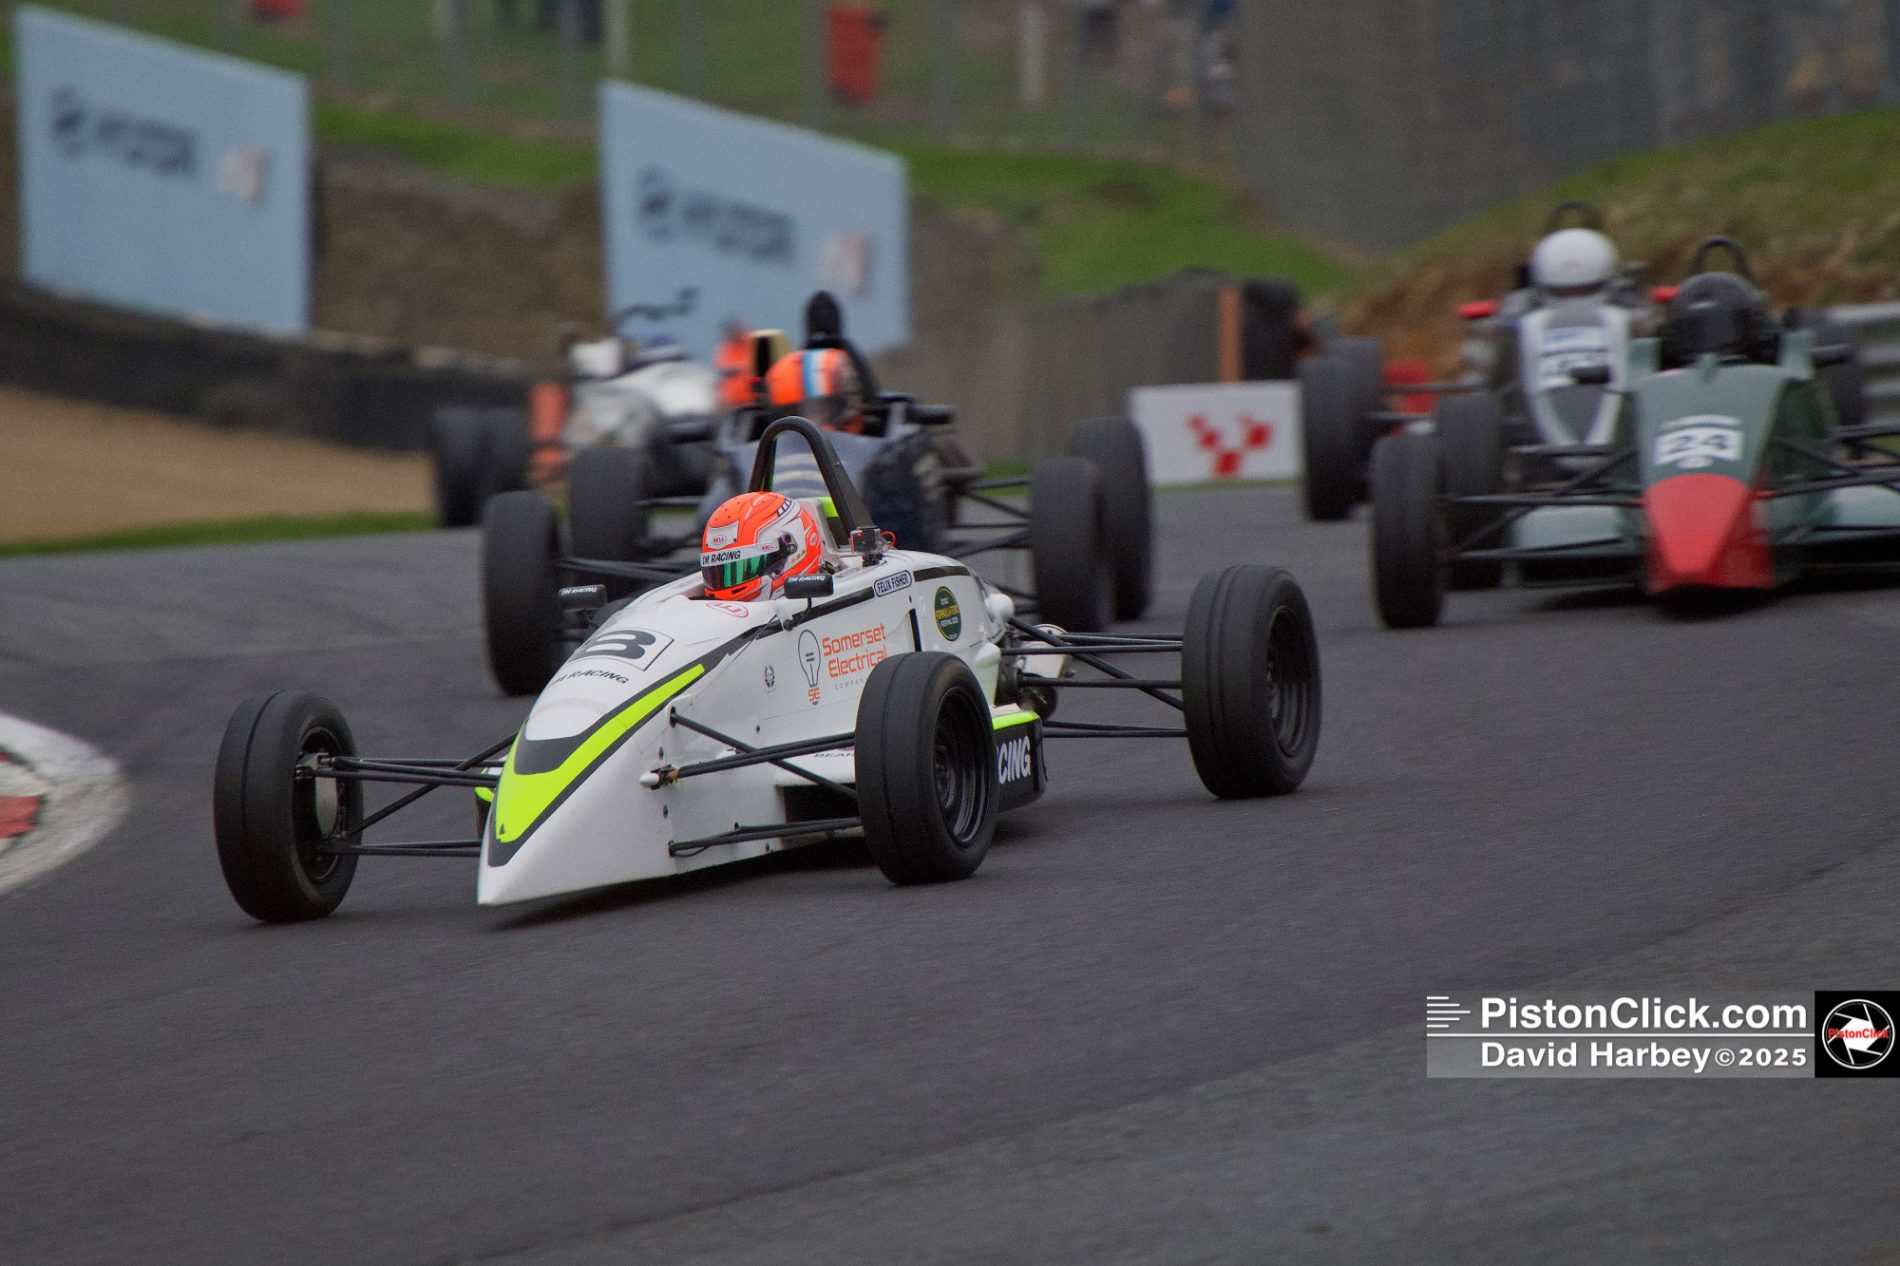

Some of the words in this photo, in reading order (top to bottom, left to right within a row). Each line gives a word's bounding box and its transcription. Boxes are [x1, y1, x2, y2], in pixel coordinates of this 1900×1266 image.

[711, 550, 741, 562] RACING
[877, 579, 892, 593] FELIX
[892, 573, 909, 589] FISHER
[821, 623, 886, 657] Somerset
[827, 643, 888, 678] Electrical
[568, 669, 630, 684] RACING
[834, 678, 865, 690] COMPAN
[808, 687, 820, 701] SE
[996, 735, 1031, 785] CING
